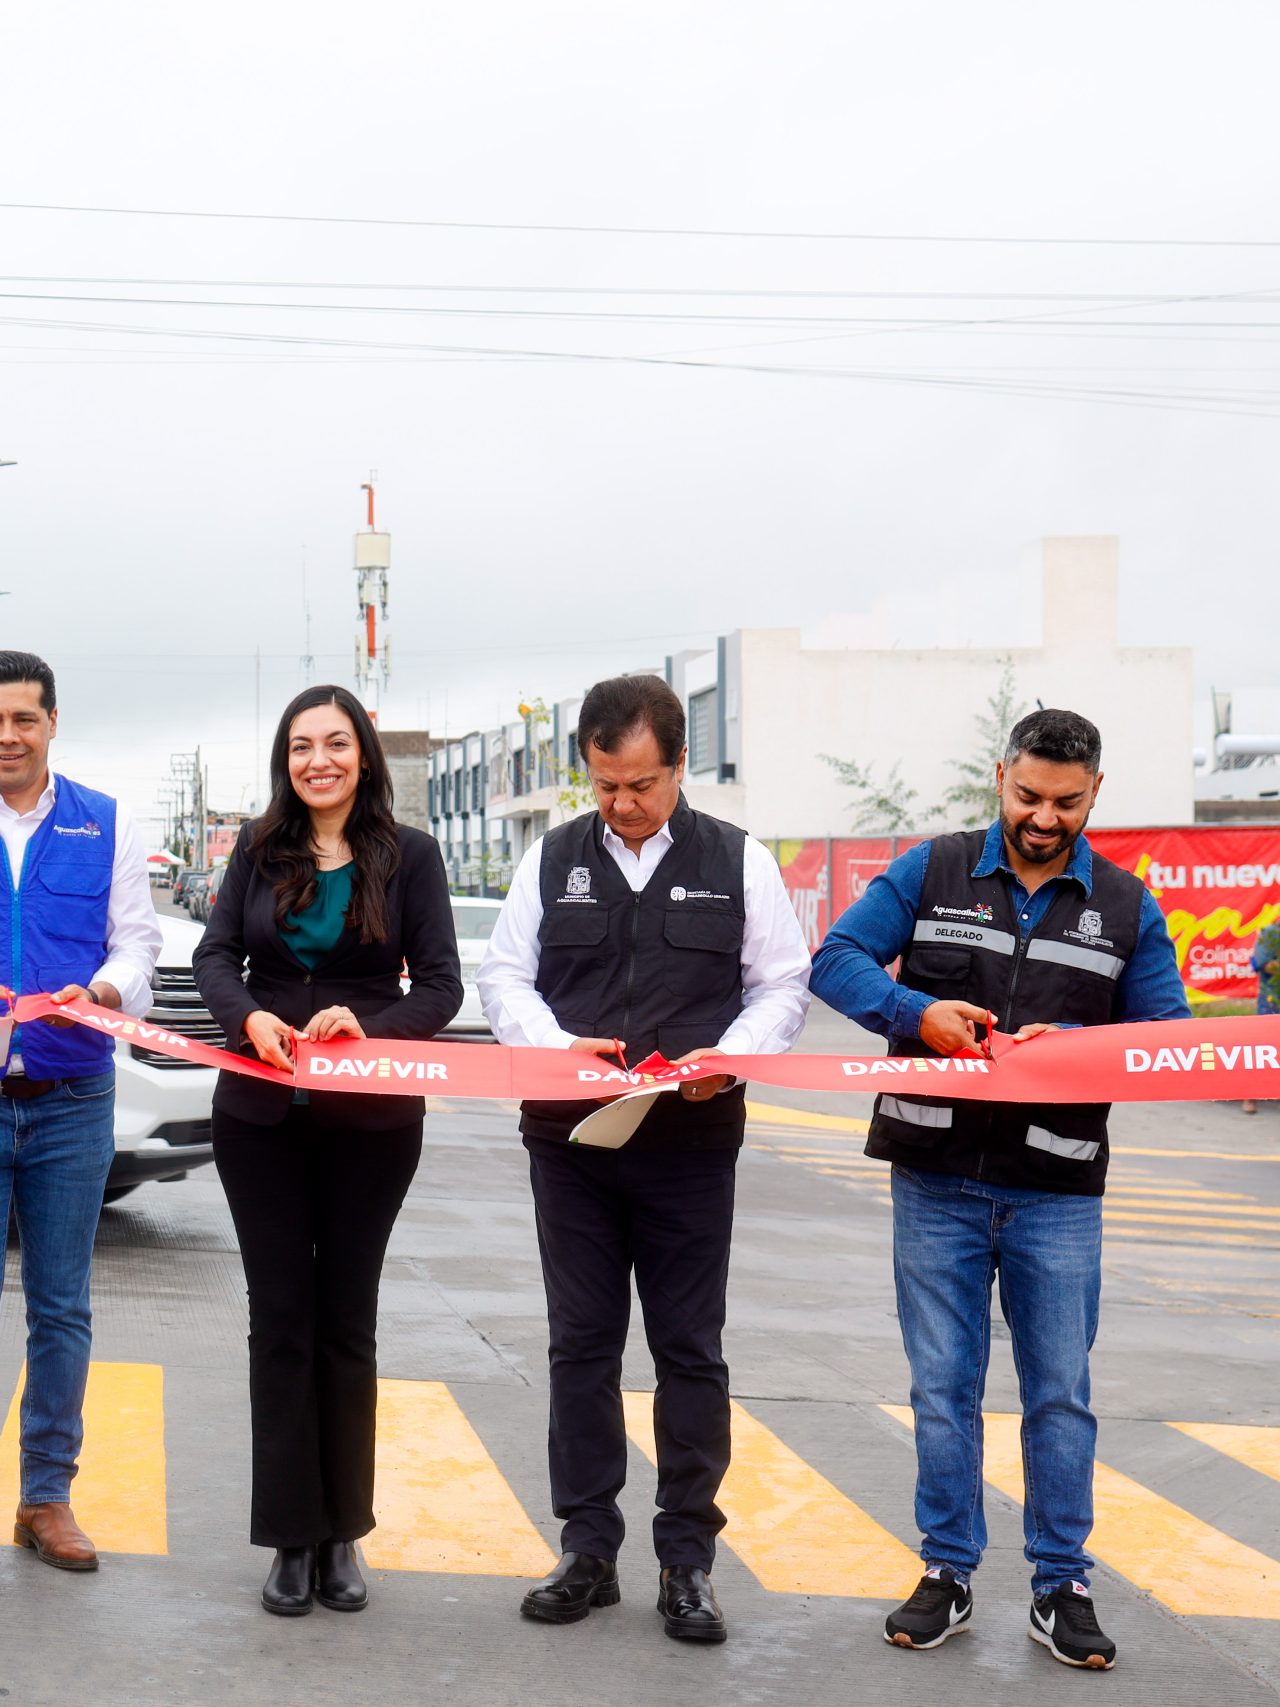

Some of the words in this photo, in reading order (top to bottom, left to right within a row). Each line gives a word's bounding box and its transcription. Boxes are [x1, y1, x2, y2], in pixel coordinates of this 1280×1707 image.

[1149, 862, 1186, 888] tu
[1193, 864, 1280, 888] nuev
[935, 928, 983, 941] DELEGADO
[1189, 964, 1223, 980] San
